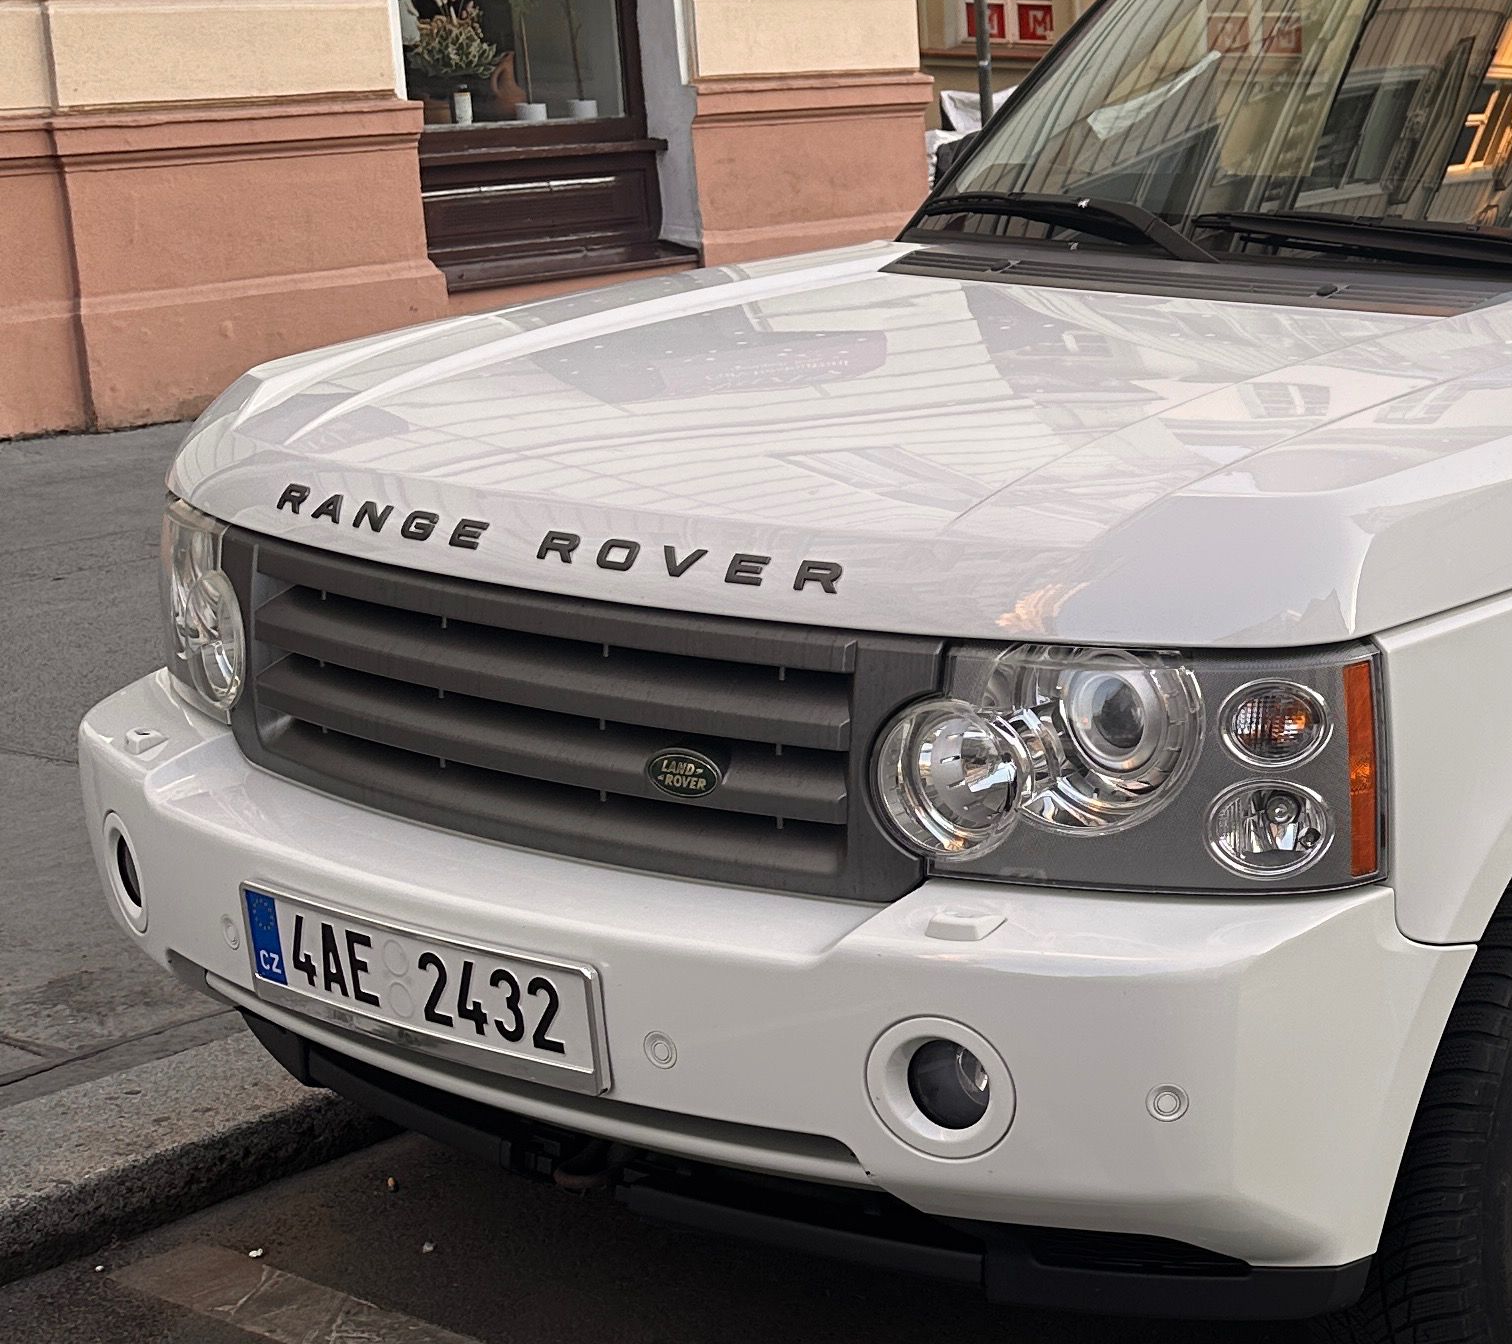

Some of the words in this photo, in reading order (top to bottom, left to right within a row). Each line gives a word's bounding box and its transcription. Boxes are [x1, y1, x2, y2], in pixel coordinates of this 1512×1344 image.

[276, 483, 490, 551] RANGE
[536, 530, 844, 594] ROVER
[661, 759, 696, 776] LAND
[664, 773, 707, 791] ROVER
[259, 948, 283, 975] CZ
[291, 913, 382, 1008] 4AE
[417, 950, 566, 1055] 2432
